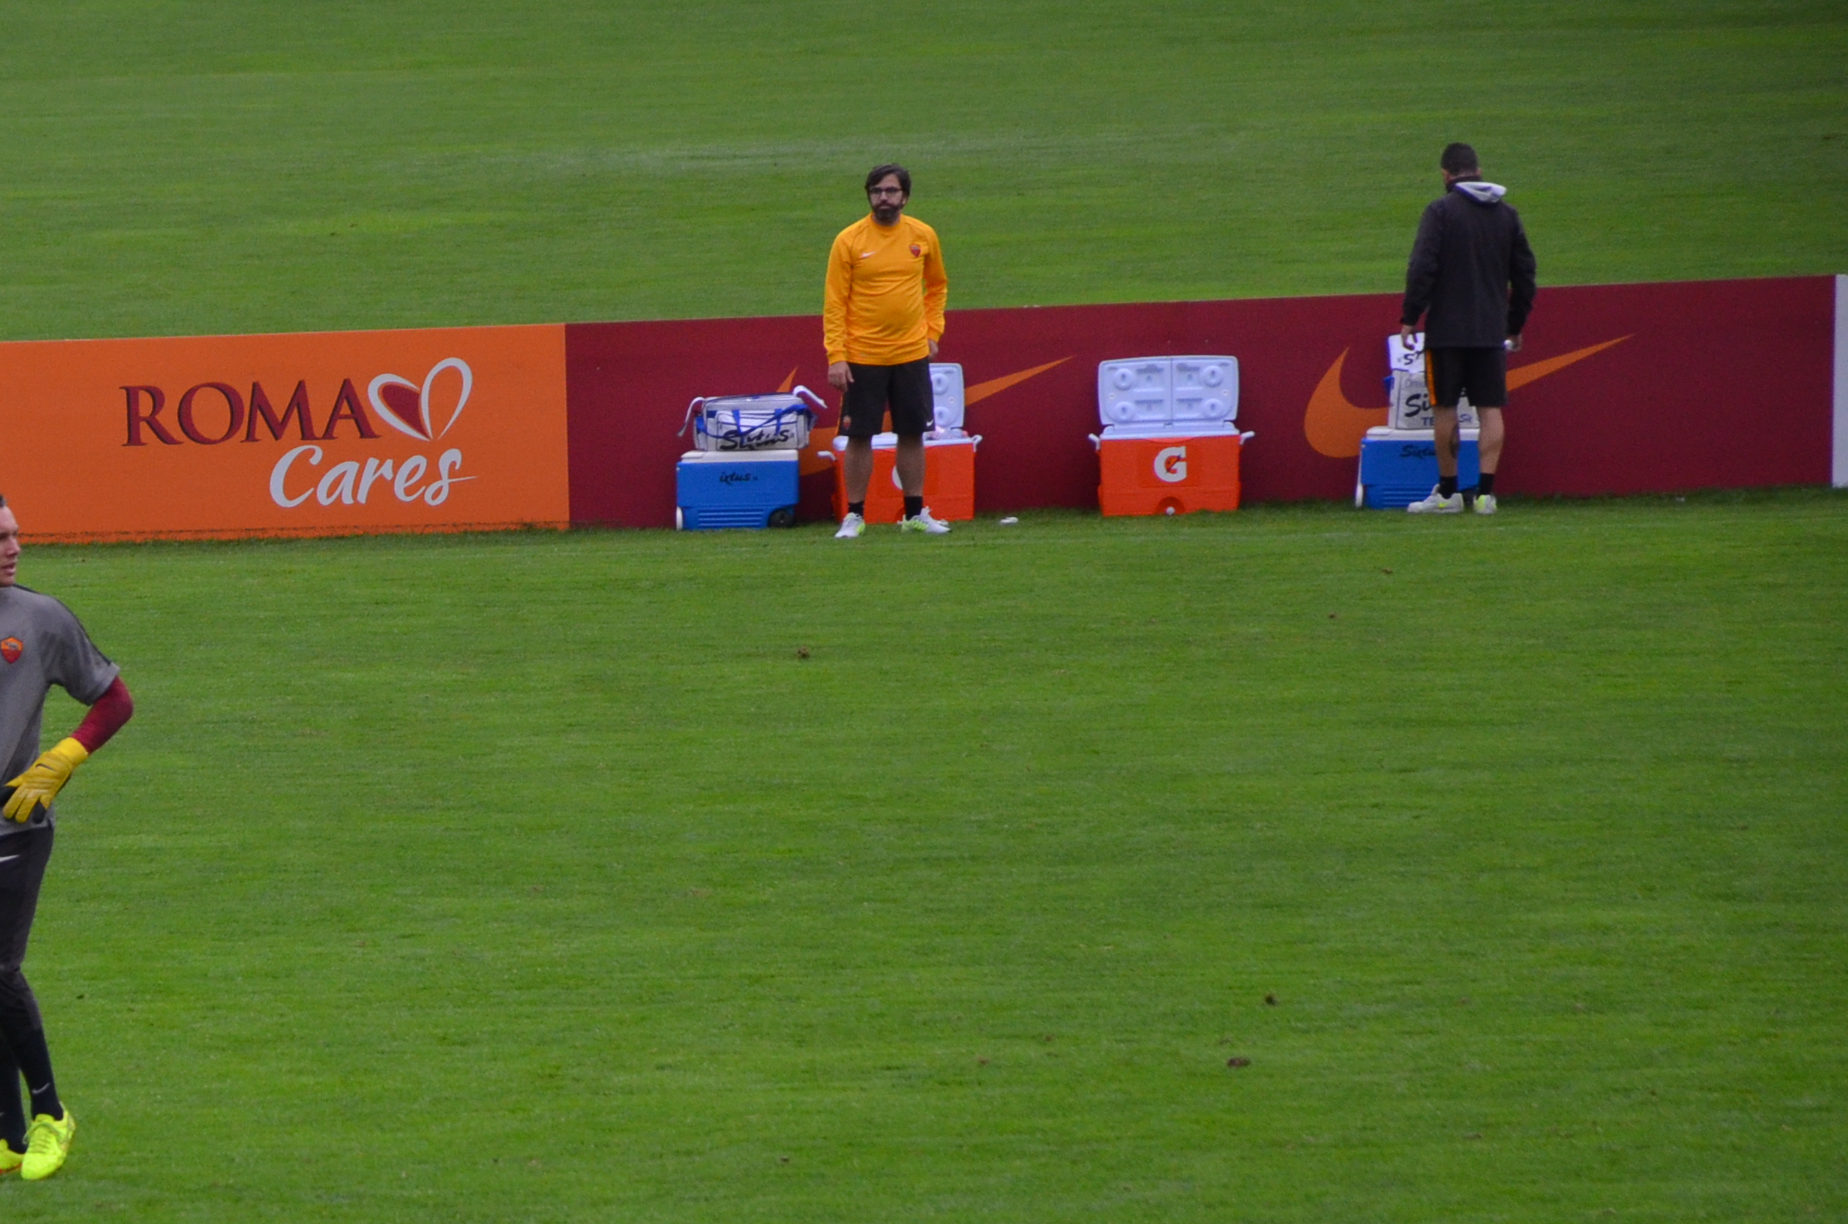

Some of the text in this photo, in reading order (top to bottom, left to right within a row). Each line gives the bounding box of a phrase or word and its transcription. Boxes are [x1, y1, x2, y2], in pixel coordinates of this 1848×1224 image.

[119, 378, 382, 447] ROMA
[269, 445, 479, 508] Cares
[1154, 446, 1187, 482] G
